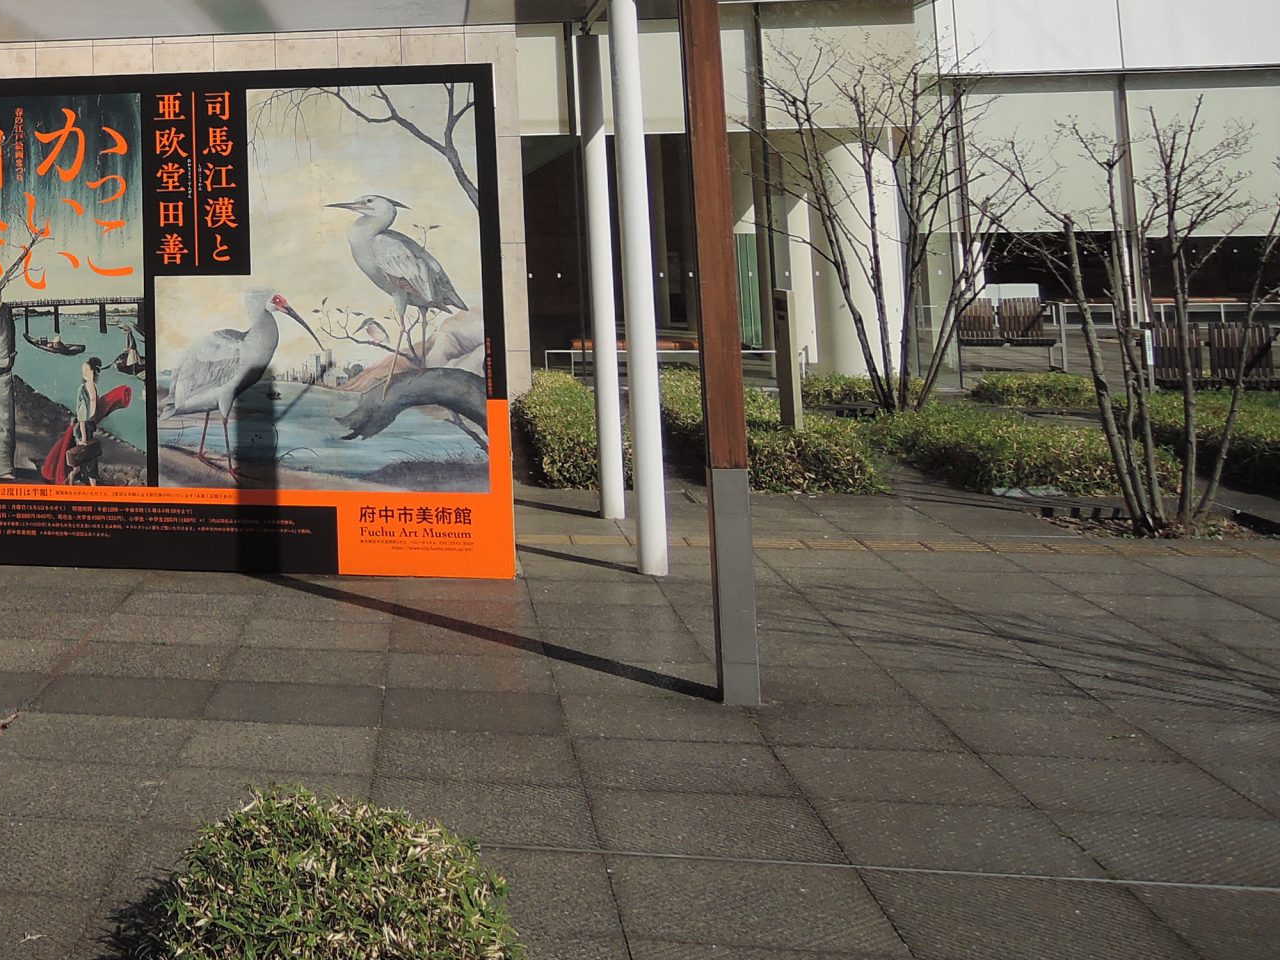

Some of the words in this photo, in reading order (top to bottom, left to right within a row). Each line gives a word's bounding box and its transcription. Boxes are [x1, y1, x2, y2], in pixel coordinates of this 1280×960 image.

[153, 92, 189, 265] 亜欧堂田善
[203, 91, 238, 262] 司馬江漢と
[359, 505, 472, 525] 府中市美術館
[360, 526, 395, 537] Fuchu
[399, 528, 418, 538] Art
[422, 528, 472, 539] Museum
